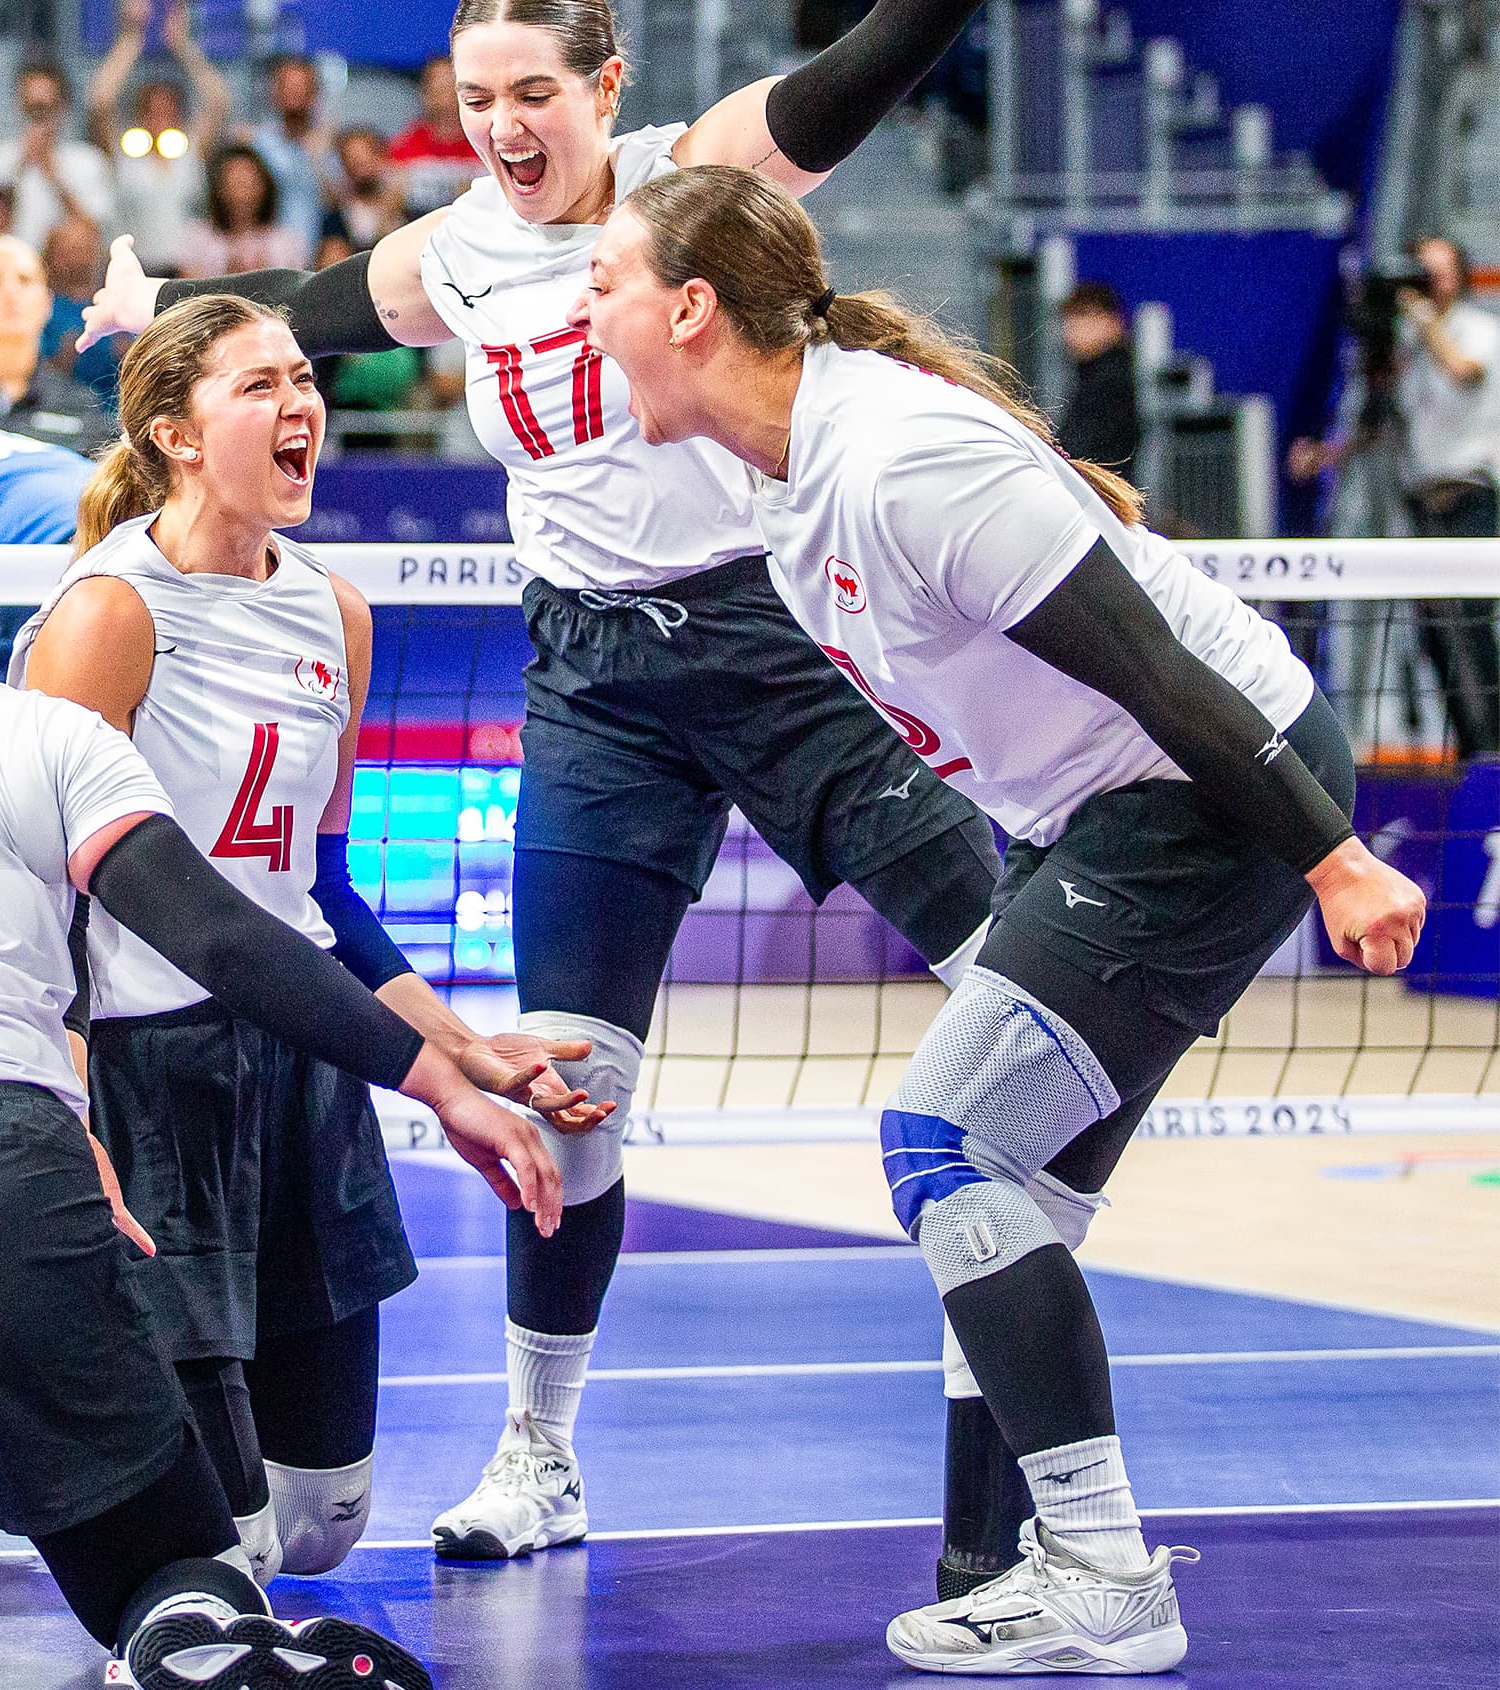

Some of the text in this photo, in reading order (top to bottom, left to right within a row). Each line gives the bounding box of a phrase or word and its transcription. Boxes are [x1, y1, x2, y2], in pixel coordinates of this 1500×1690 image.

[481, 327, 604, 461] 17
[401, 556, 523, 585] PARIS
[1237, 552, 1344, 582] 2024
[208, 722, 294, 873] 4
[1244, 1103, 1353, 1136] 2024
